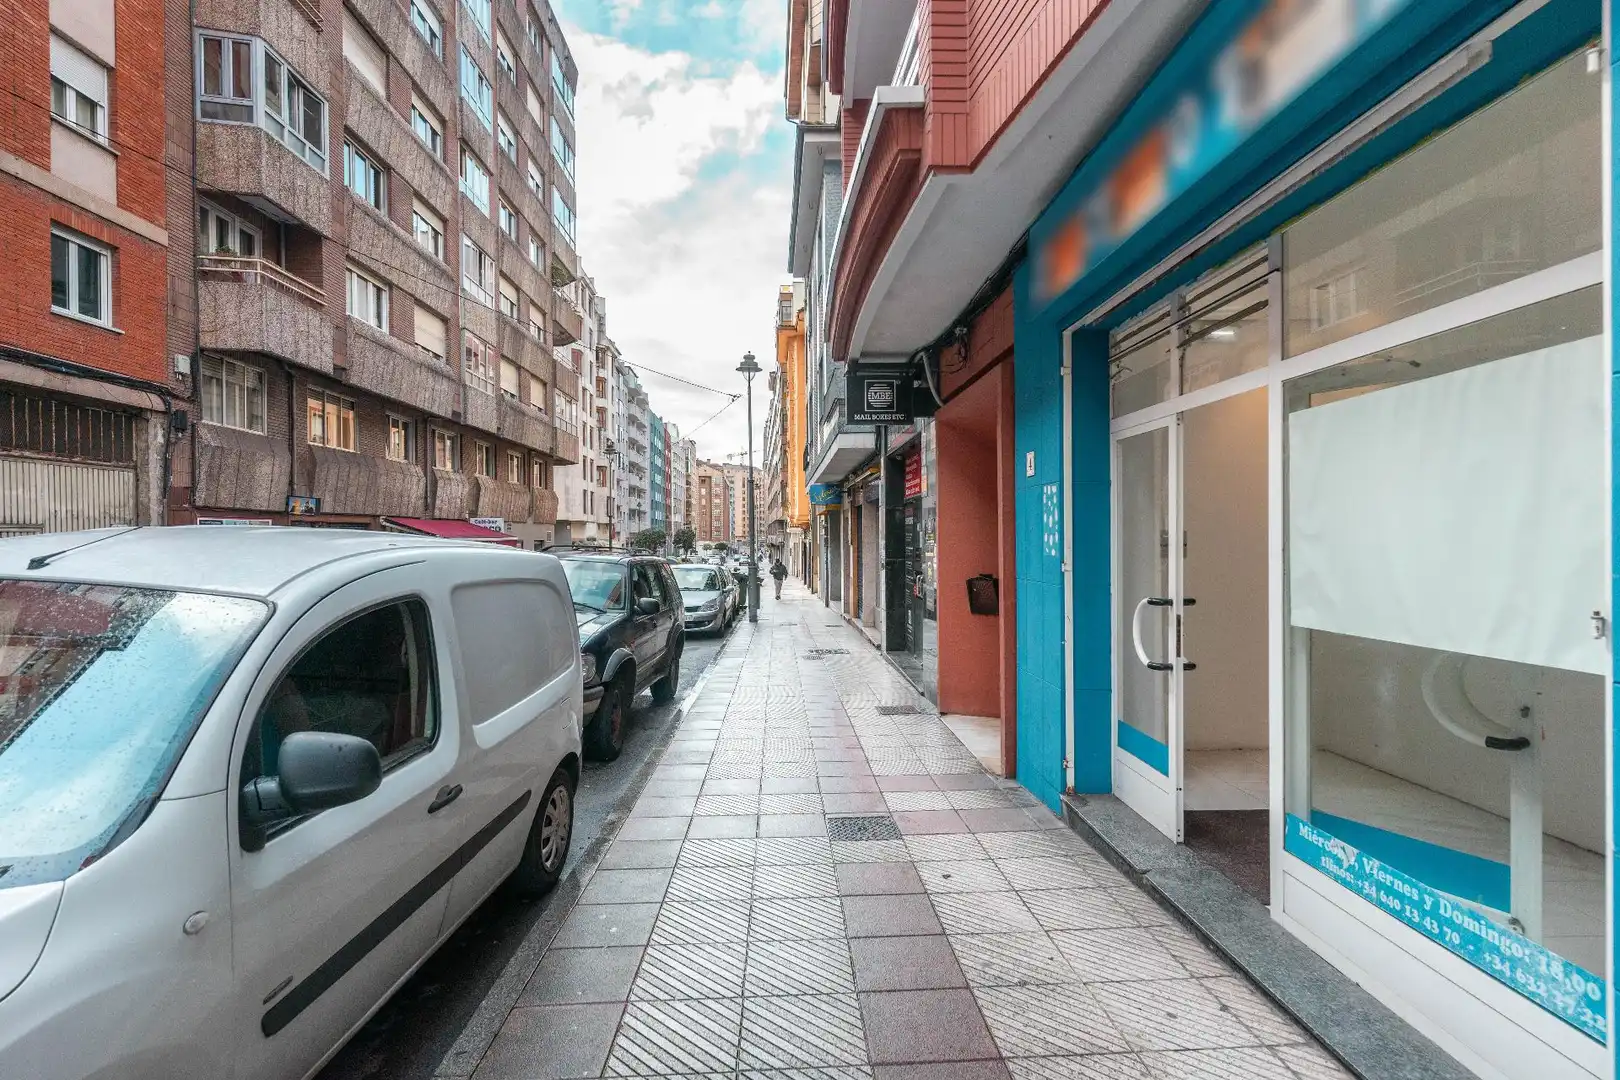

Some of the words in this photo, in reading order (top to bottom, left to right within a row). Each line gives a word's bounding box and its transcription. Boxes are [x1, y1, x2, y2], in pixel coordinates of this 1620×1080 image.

[871, 392, 891, 400] MBE
[1362, 857, 1419, 901] Viernes
[1422, 893, 1435, 911] y
[1357, 879, 1377, 899] +34
[1379, 890, 1402, 912] 640
[1404, 905, 1420, 923] 13
[1423, 916, 1440, 934] 43
[1442, 927, 1461, 945] 70
[1484, 951, 1511, 978] +34
